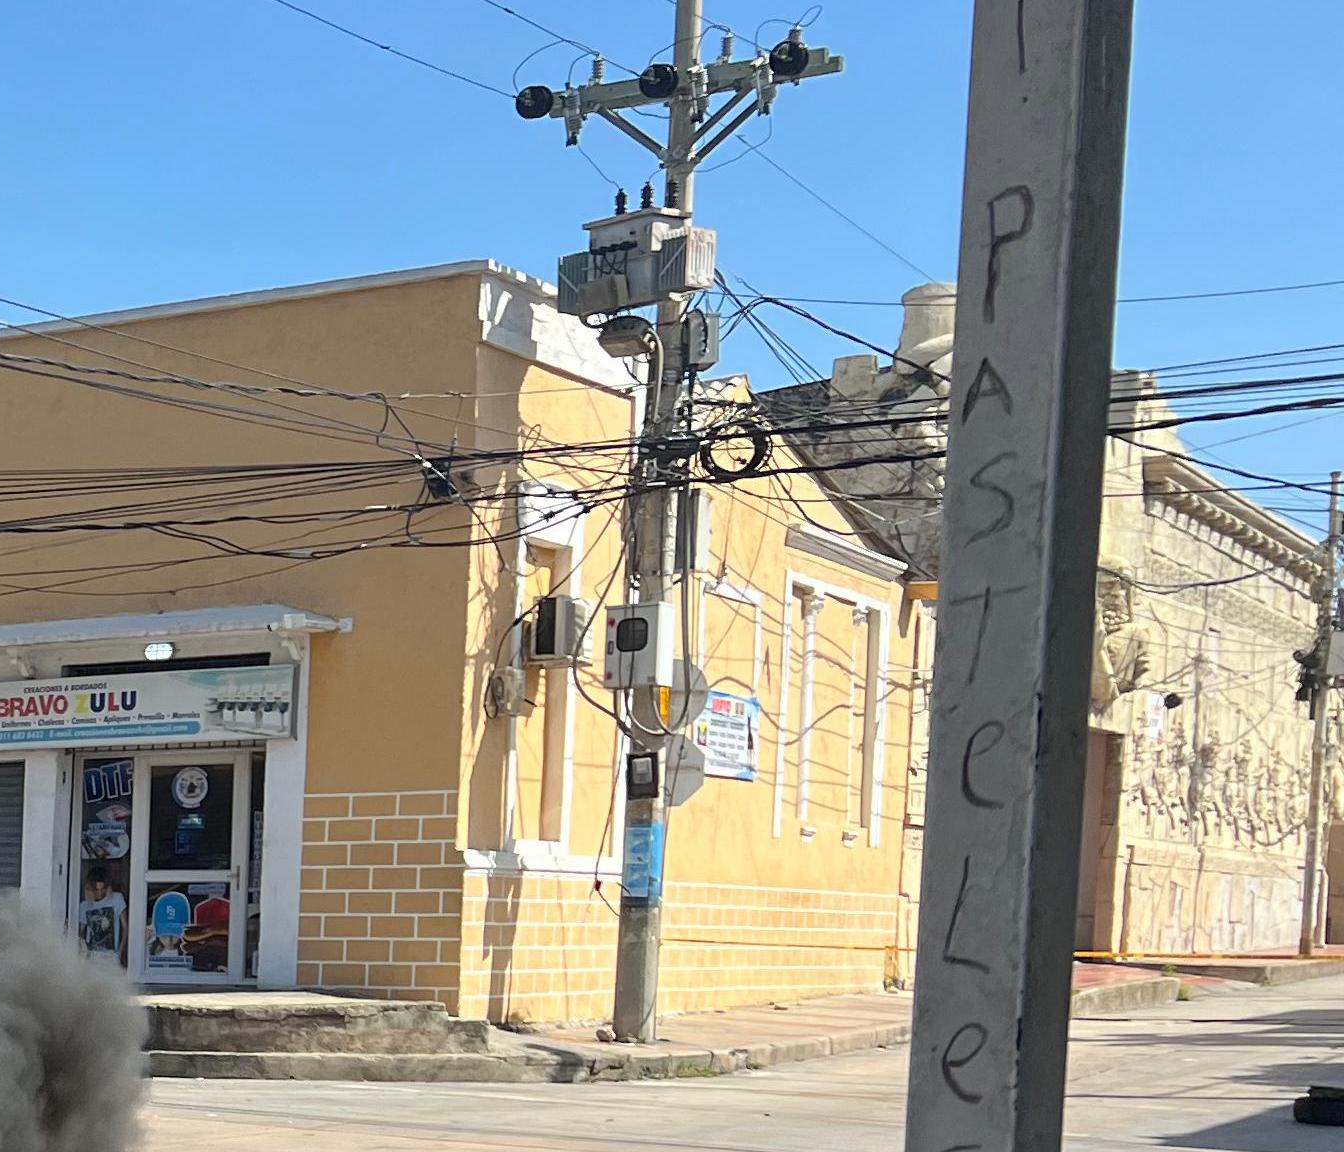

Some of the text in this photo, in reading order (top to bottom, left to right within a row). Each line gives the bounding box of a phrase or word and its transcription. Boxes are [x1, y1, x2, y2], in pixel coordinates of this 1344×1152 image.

[23, 685, 62, 694] CREACIONES
[71, 682, 107, 691] BORDADOS
[75, 690, 137, 713] ZULU
[83, 760, 133, 803] DTF
